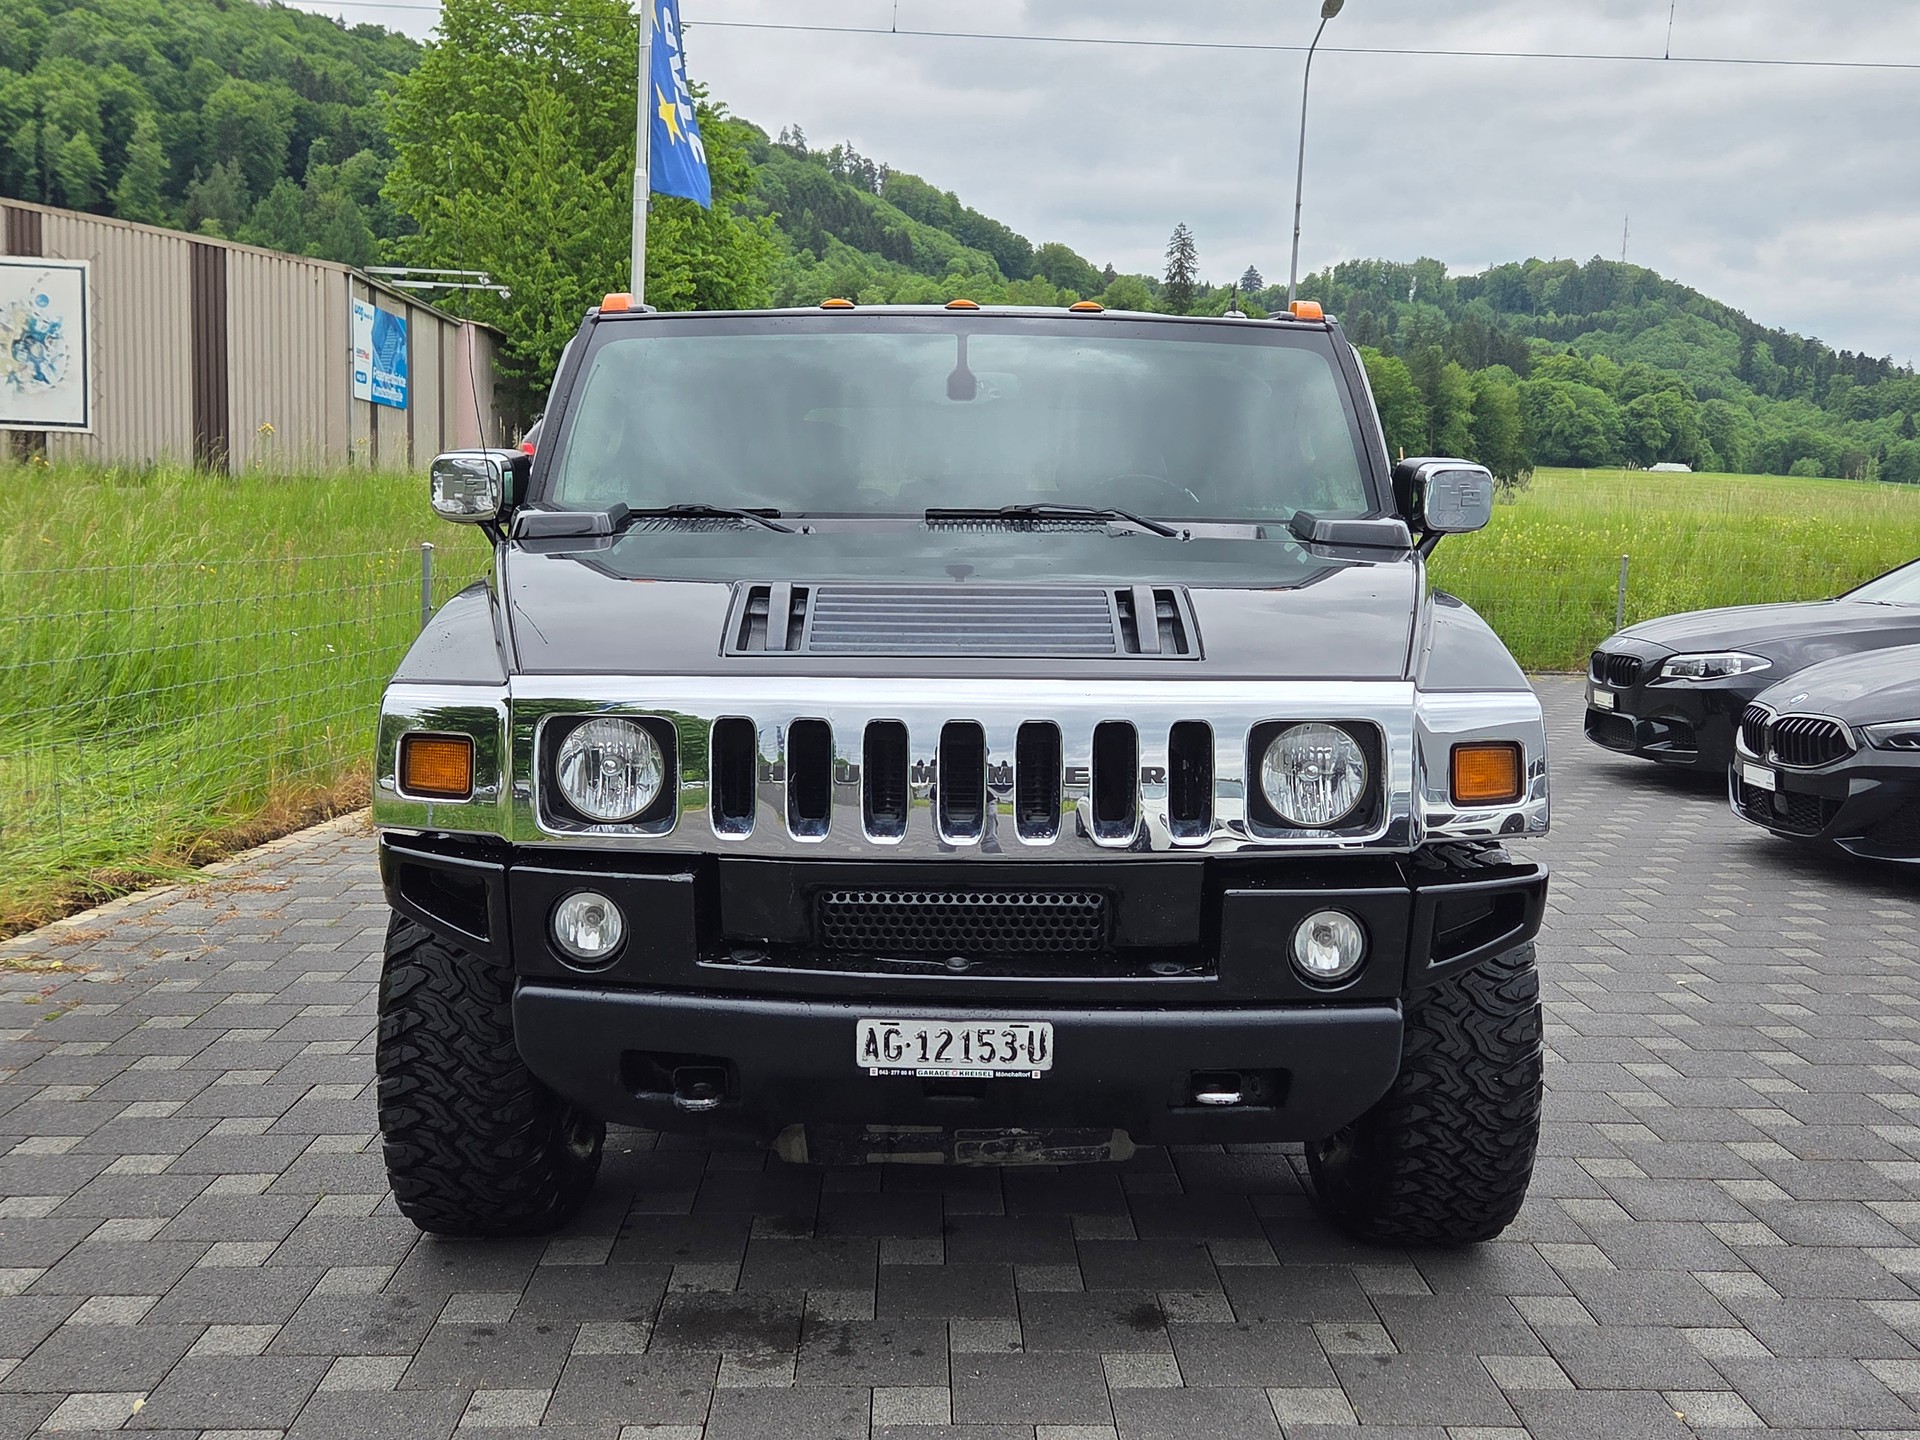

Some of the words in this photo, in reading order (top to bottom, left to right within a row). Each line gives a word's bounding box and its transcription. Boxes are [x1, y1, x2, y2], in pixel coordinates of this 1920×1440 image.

[757, 764, 1168, 784] HUMMER
[917, 1069, 950, 1077] GARAGE
[959, 1070, 993, 1078] KREISEL
